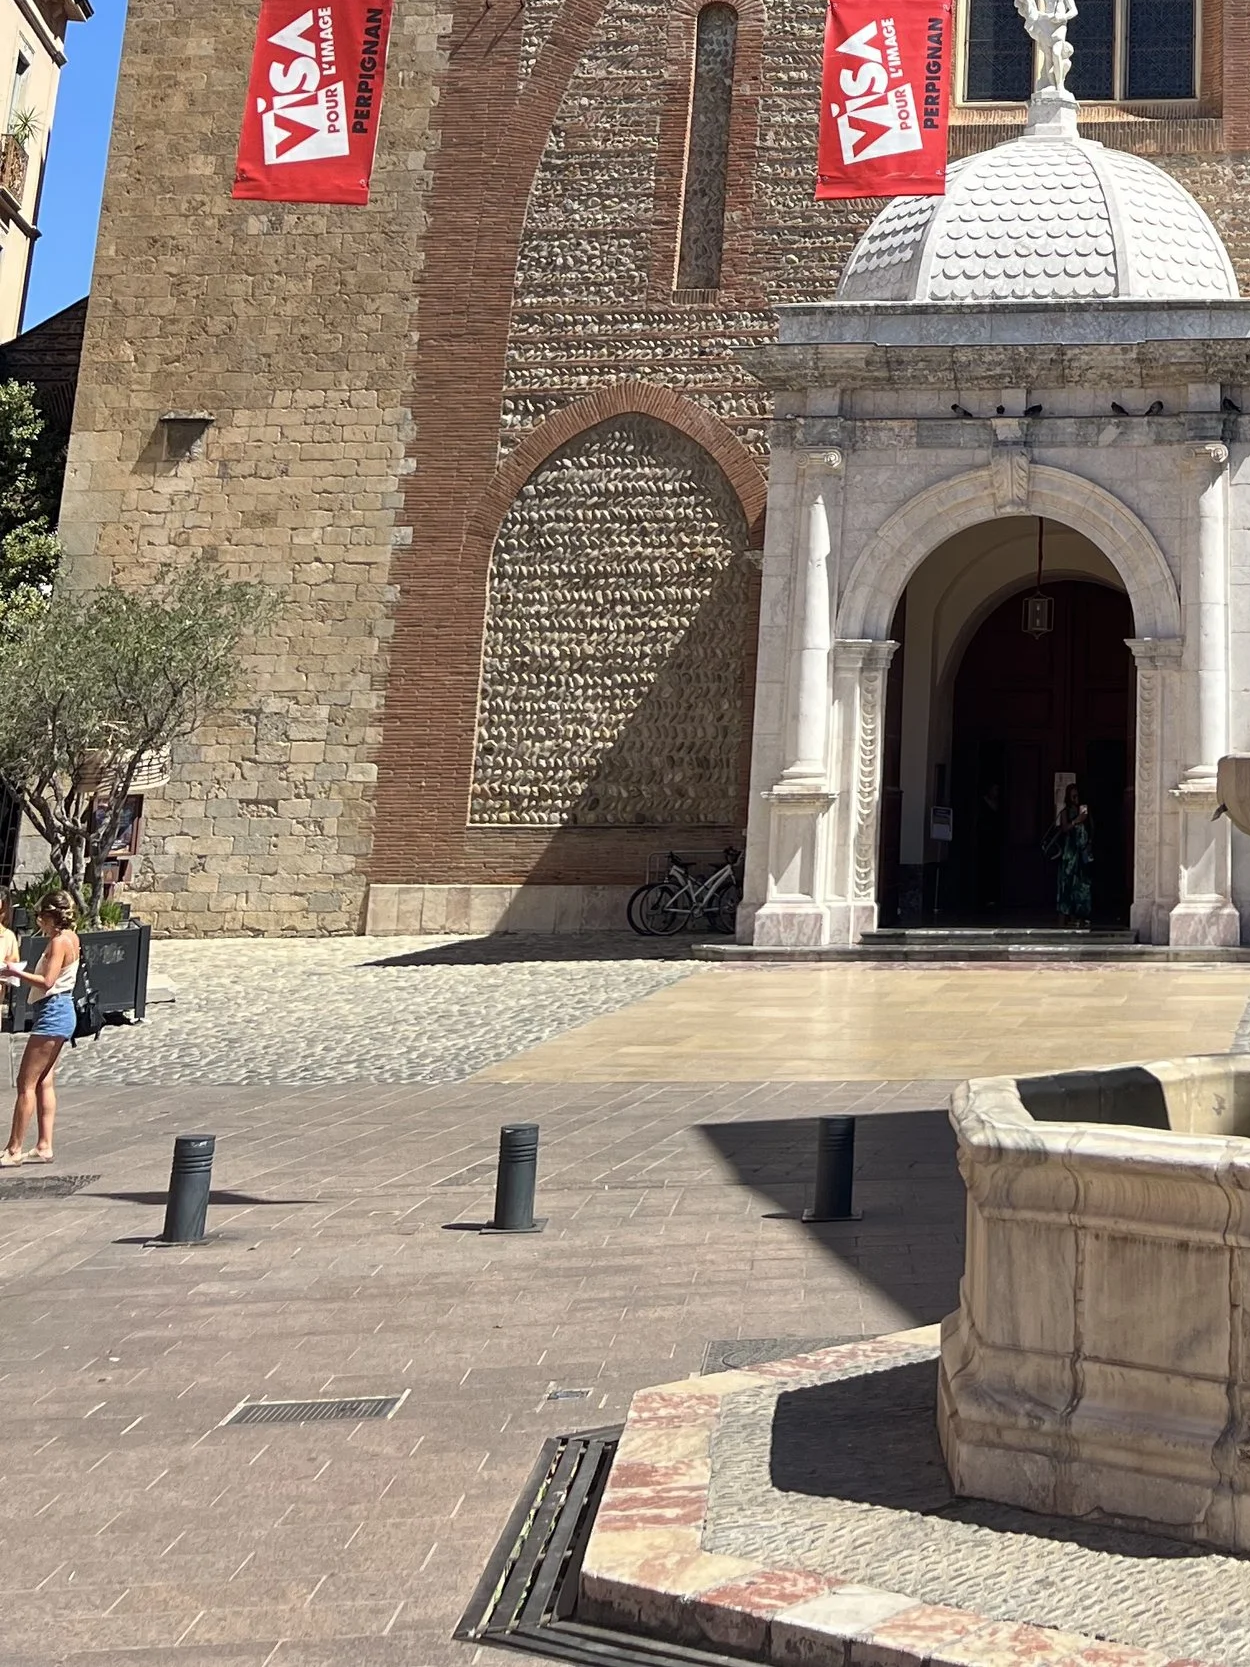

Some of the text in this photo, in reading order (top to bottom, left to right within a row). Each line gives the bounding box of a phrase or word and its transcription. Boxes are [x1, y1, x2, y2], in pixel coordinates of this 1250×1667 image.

[317, 6, 340, 134] POUR L'IMAGE
[352, 8, 383, 134] PERPIGNAN
[881, 17, 912, 131] POUR L'IMAGE
[923, 17, 943, 130] PERPIGNAN
